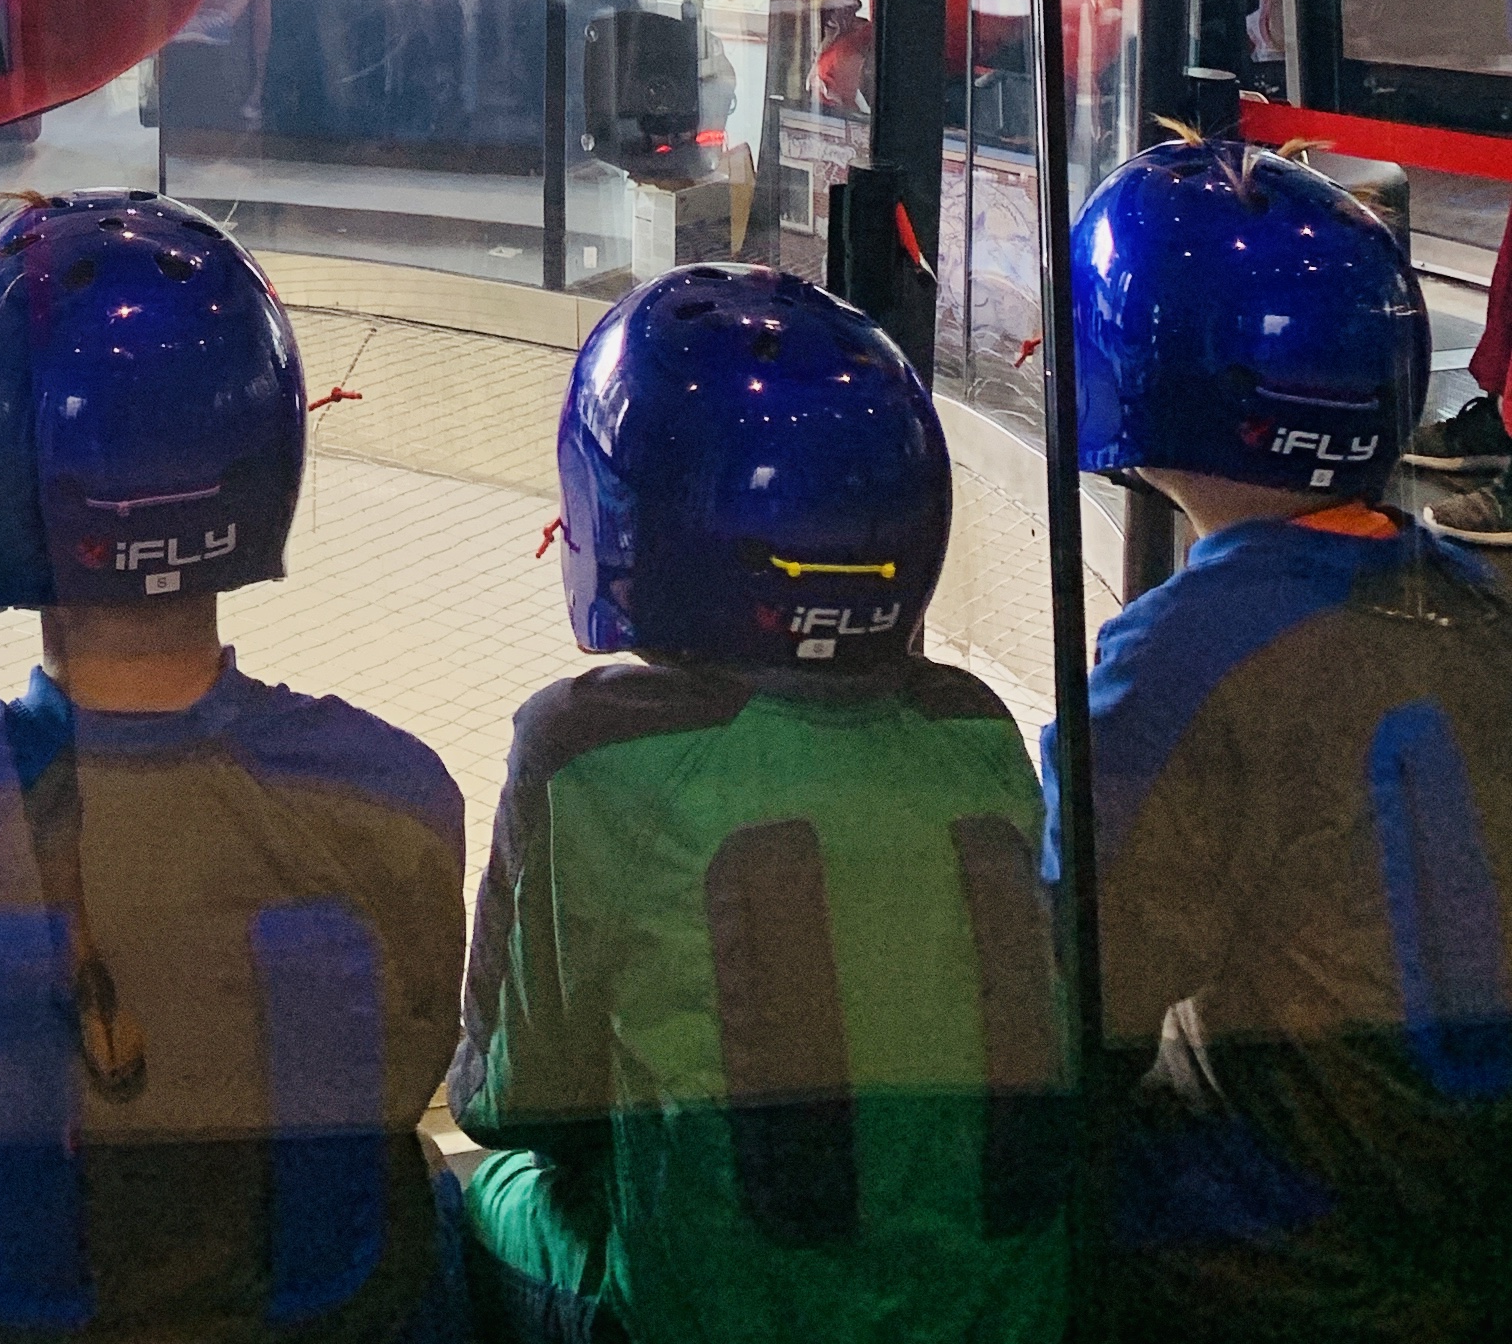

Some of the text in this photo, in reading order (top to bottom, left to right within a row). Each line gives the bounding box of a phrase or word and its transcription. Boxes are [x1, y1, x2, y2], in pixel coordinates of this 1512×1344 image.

[1271, 427, 1378, 461] iFLY
[115, 523, 236, 570] iFLY
[790, 602, 900, 635] iFLY
